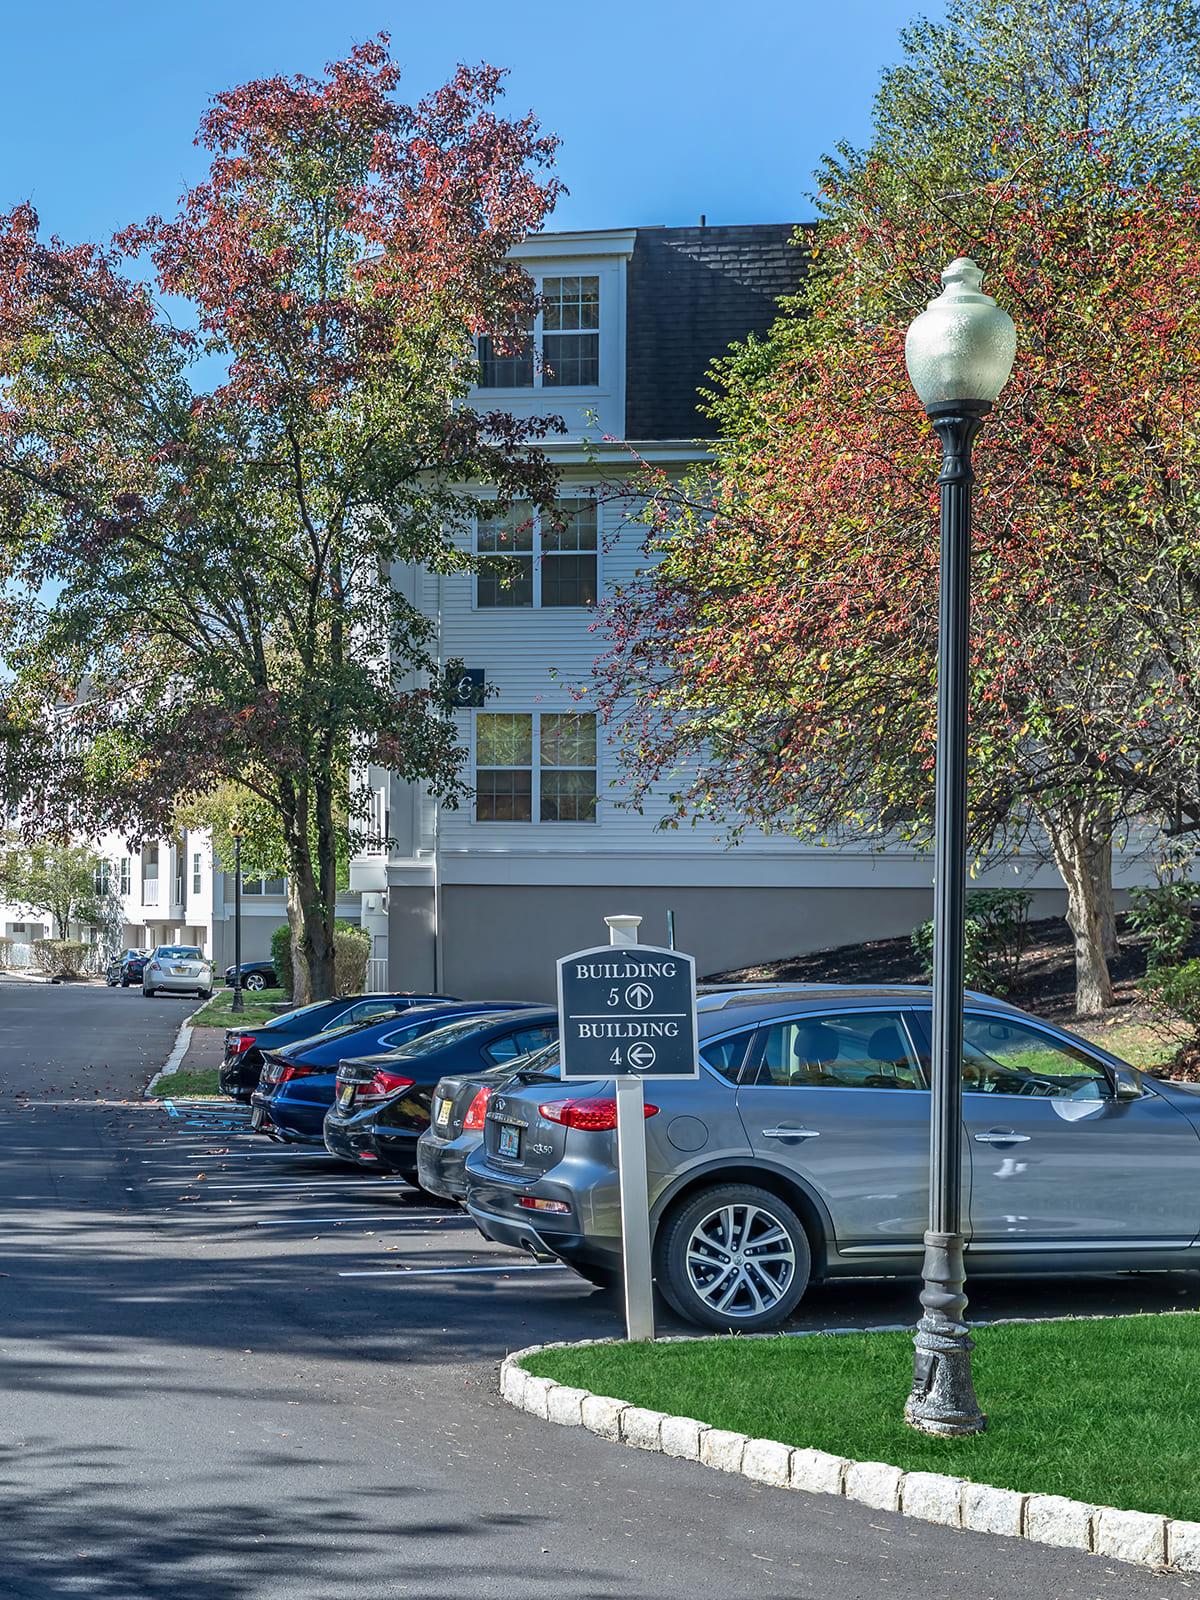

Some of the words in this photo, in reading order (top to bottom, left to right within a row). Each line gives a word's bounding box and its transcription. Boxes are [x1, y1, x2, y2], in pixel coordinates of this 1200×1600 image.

[575, 962, 677, 979] BUILDING
[607, 987, 620, 1007] 5
[578, 1022, 680, 1039] BUILDING
[609, 1047, 622, 1065] 4
